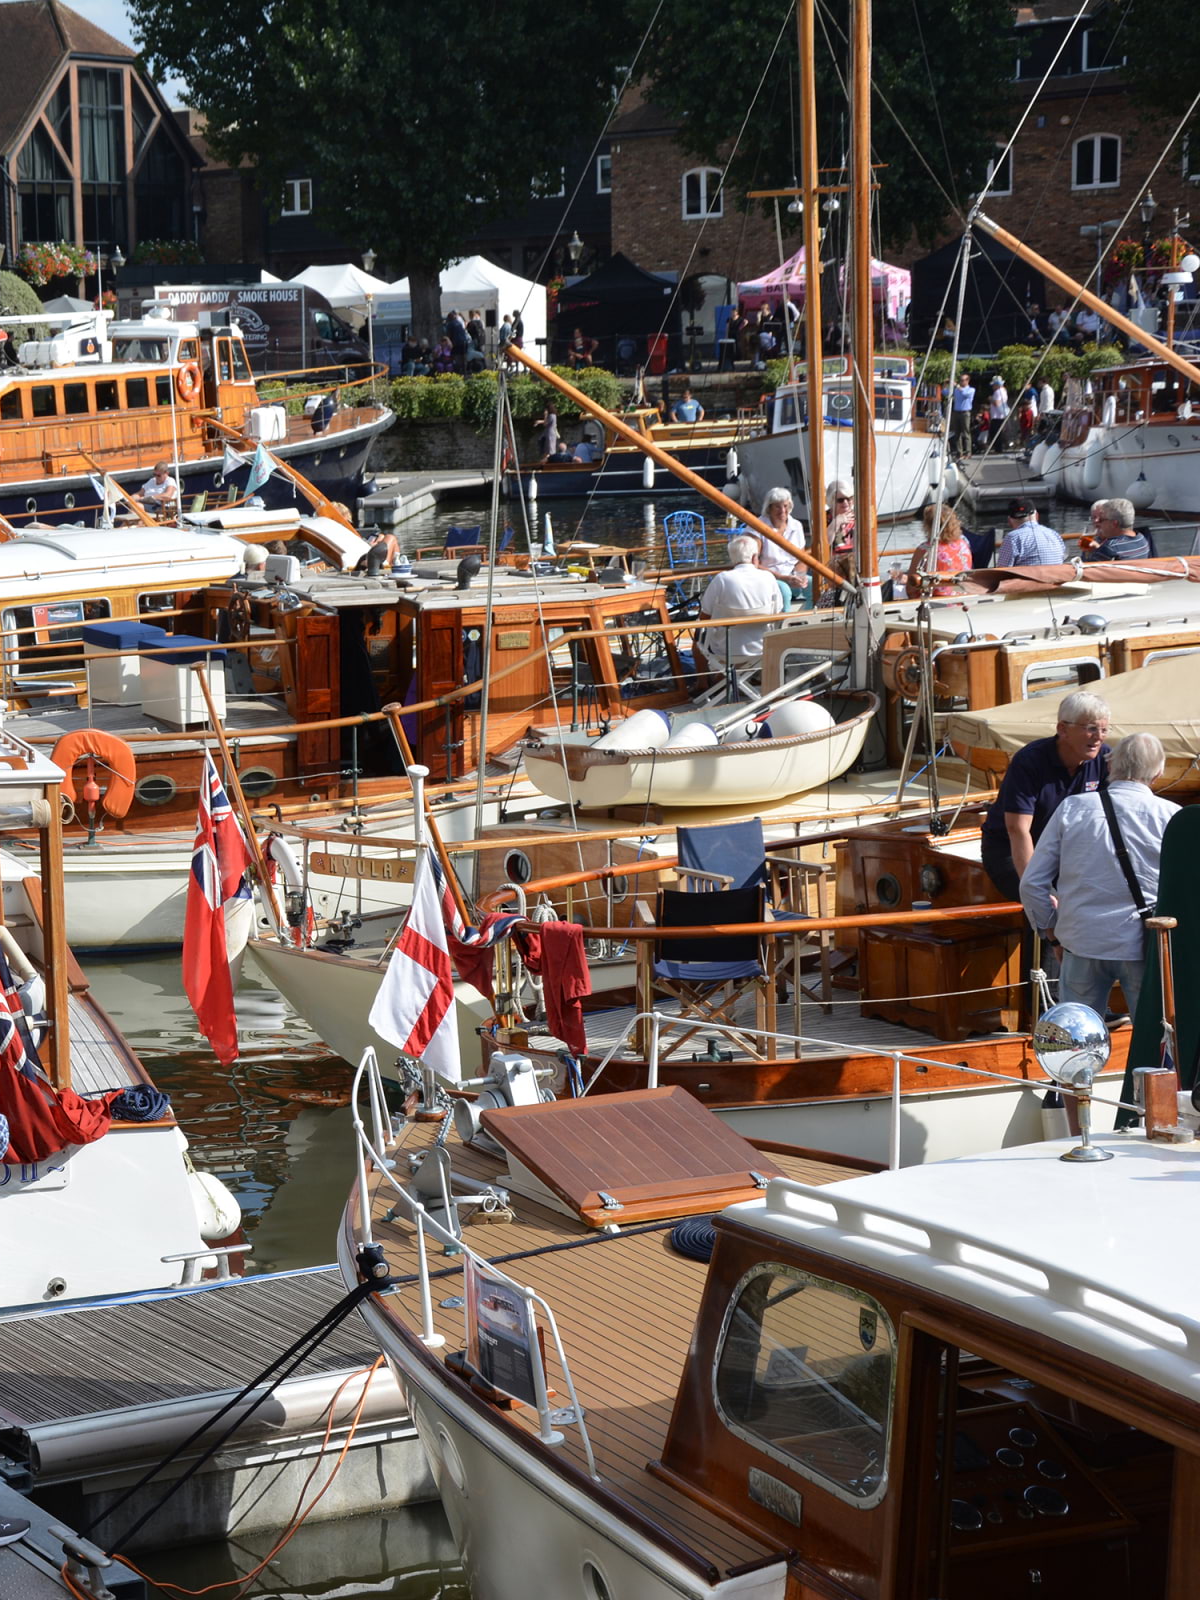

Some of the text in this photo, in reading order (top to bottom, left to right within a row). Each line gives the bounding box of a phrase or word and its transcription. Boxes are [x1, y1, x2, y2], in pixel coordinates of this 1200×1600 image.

[168, 289, 298, 304] DADDY DADDY SMOKE HOUSE
